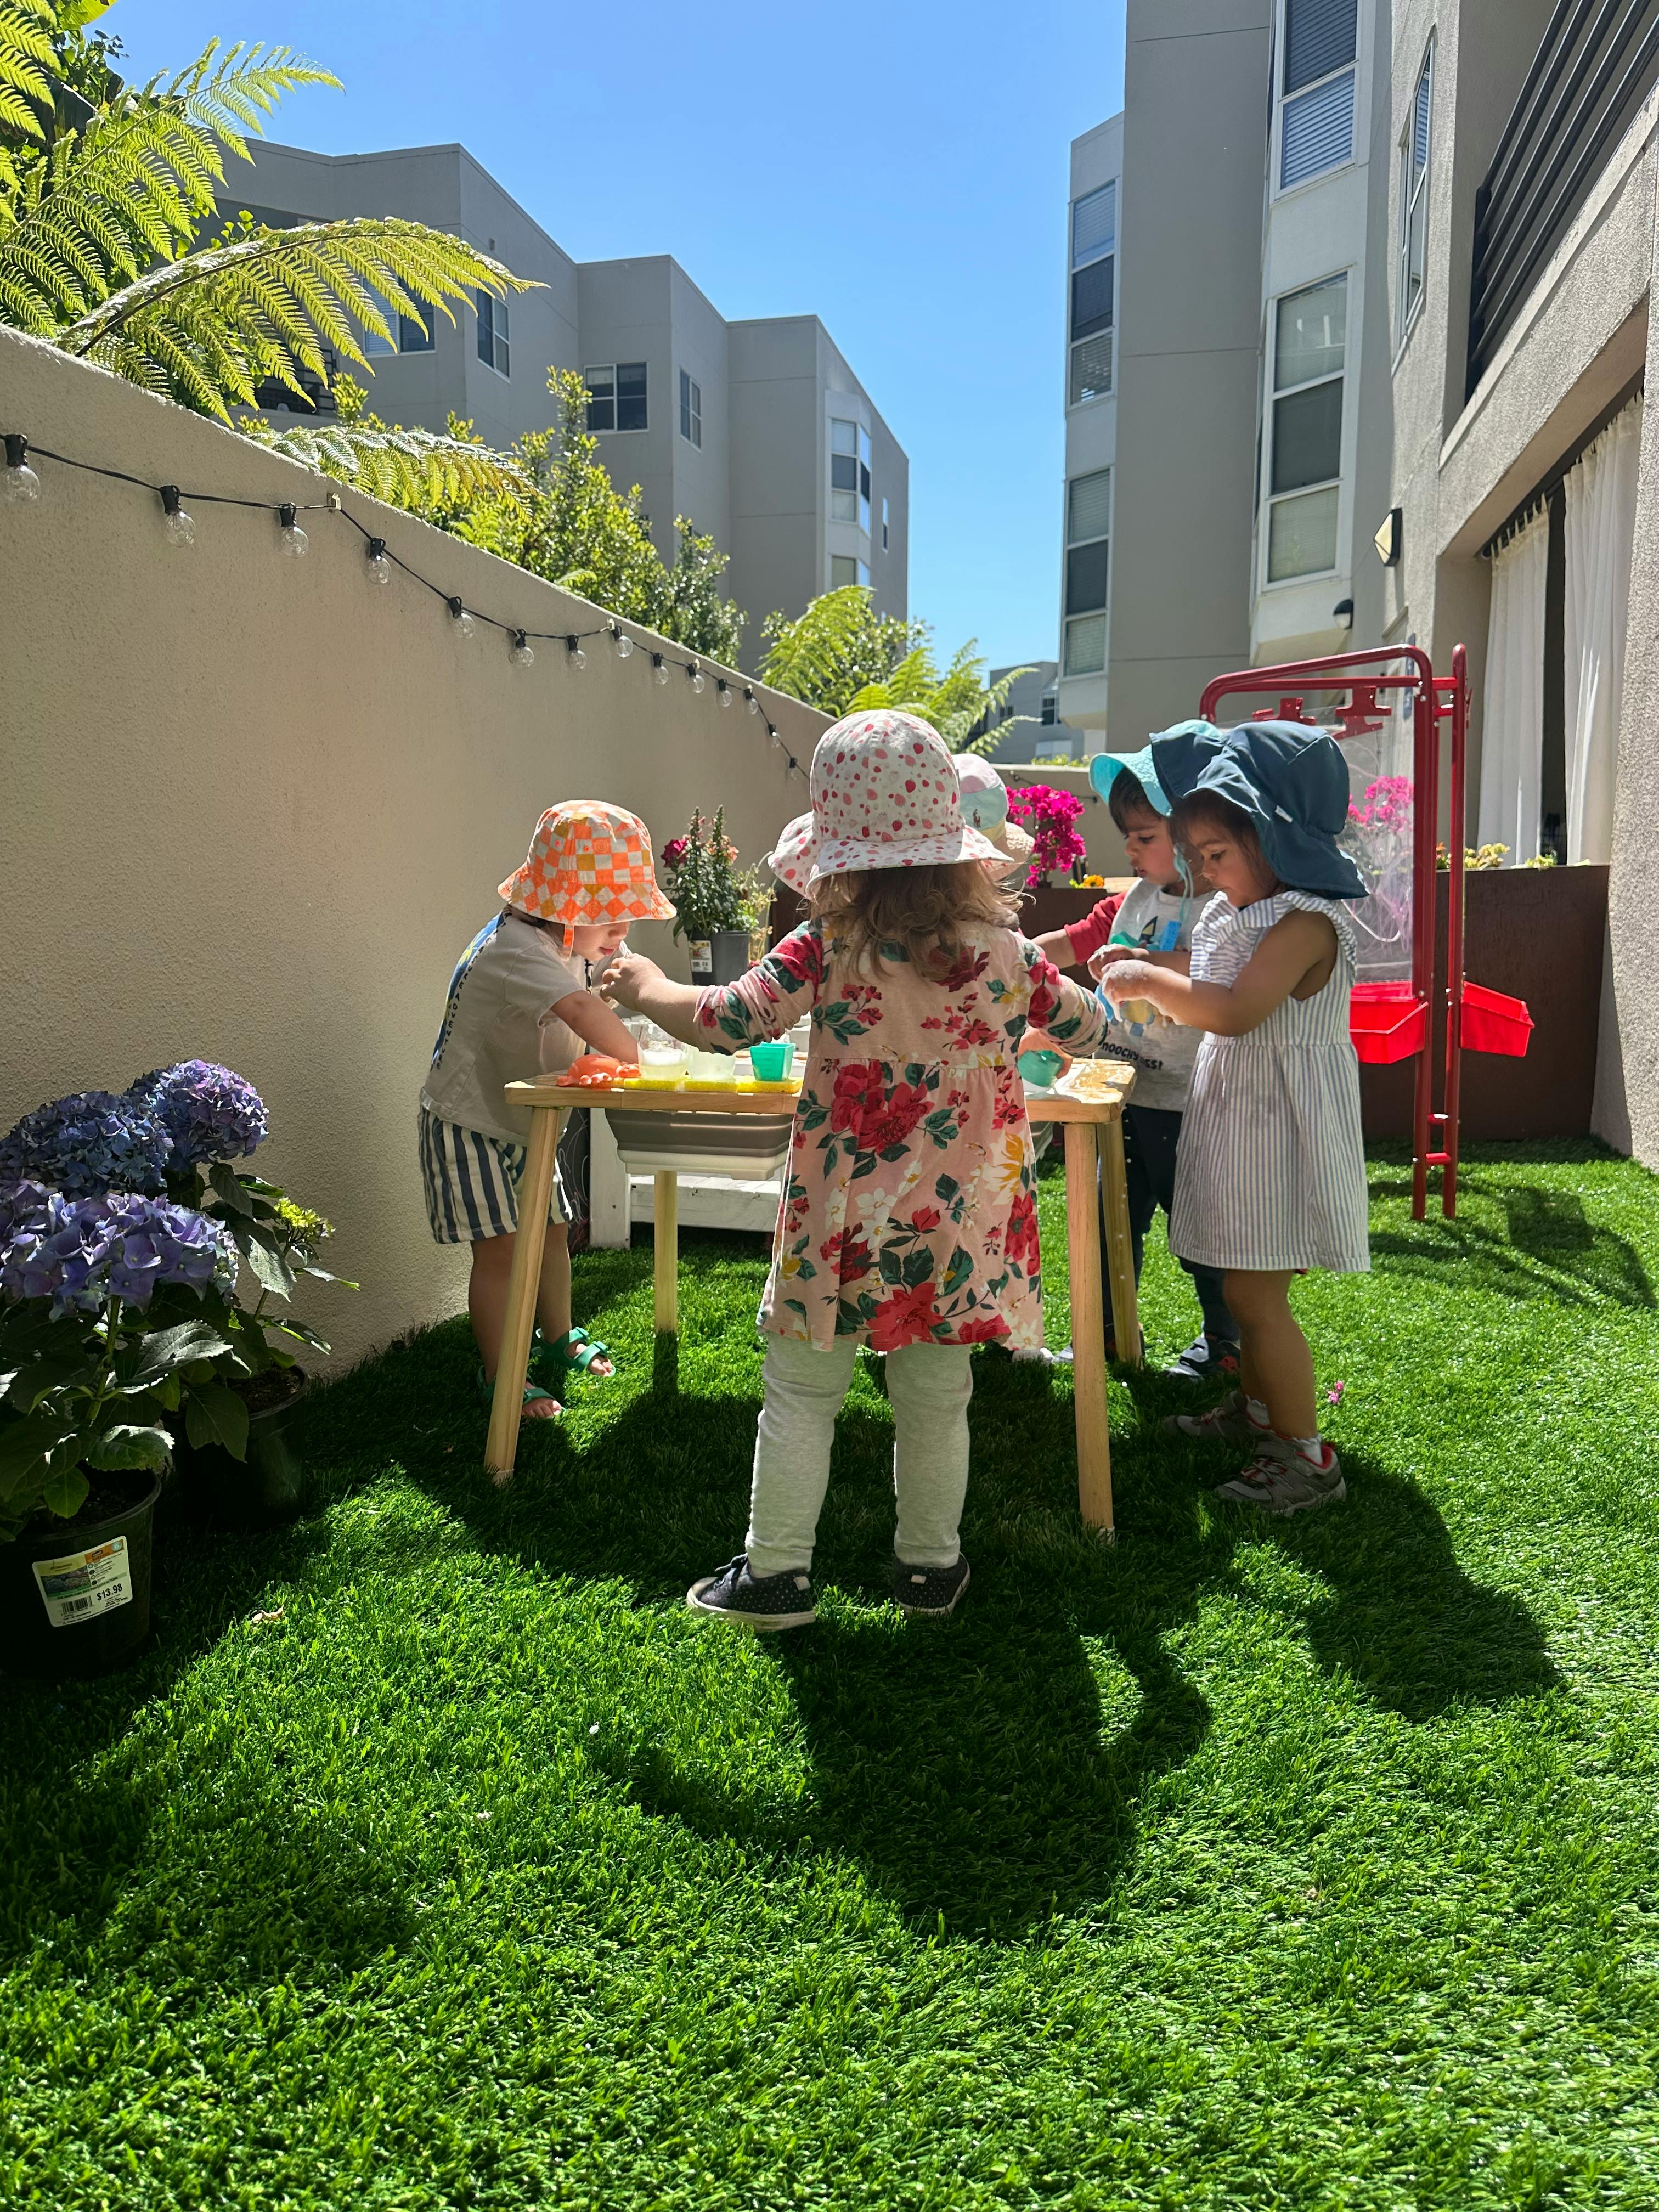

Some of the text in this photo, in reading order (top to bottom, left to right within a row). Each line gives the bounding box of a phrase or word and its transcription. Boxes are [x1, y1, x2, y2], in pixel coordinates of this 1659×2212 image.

[437, 992, 460, 1069] ADVENTURE
[1102, 1042, 1139, 1060] MOOCHY
[97, 1583, 122, 1601] $13.98
